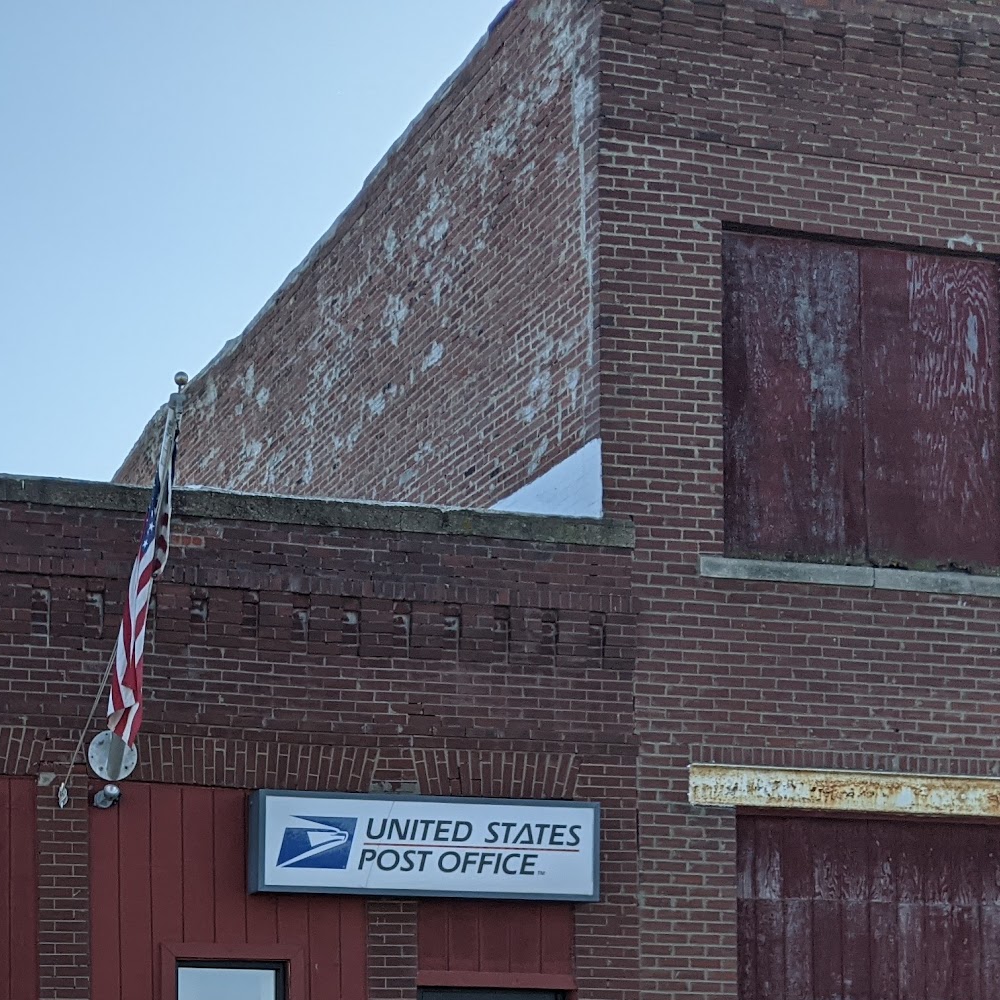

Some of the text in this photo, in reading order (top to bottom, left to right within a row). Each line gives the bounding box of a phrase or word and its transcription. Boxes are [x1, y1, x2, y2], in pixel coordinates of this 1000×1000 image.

[366, 818, 582, 847] UNITED STATES
[357, 848, 433, 872] POST
[437, 850, 539, 876] OFFICE
